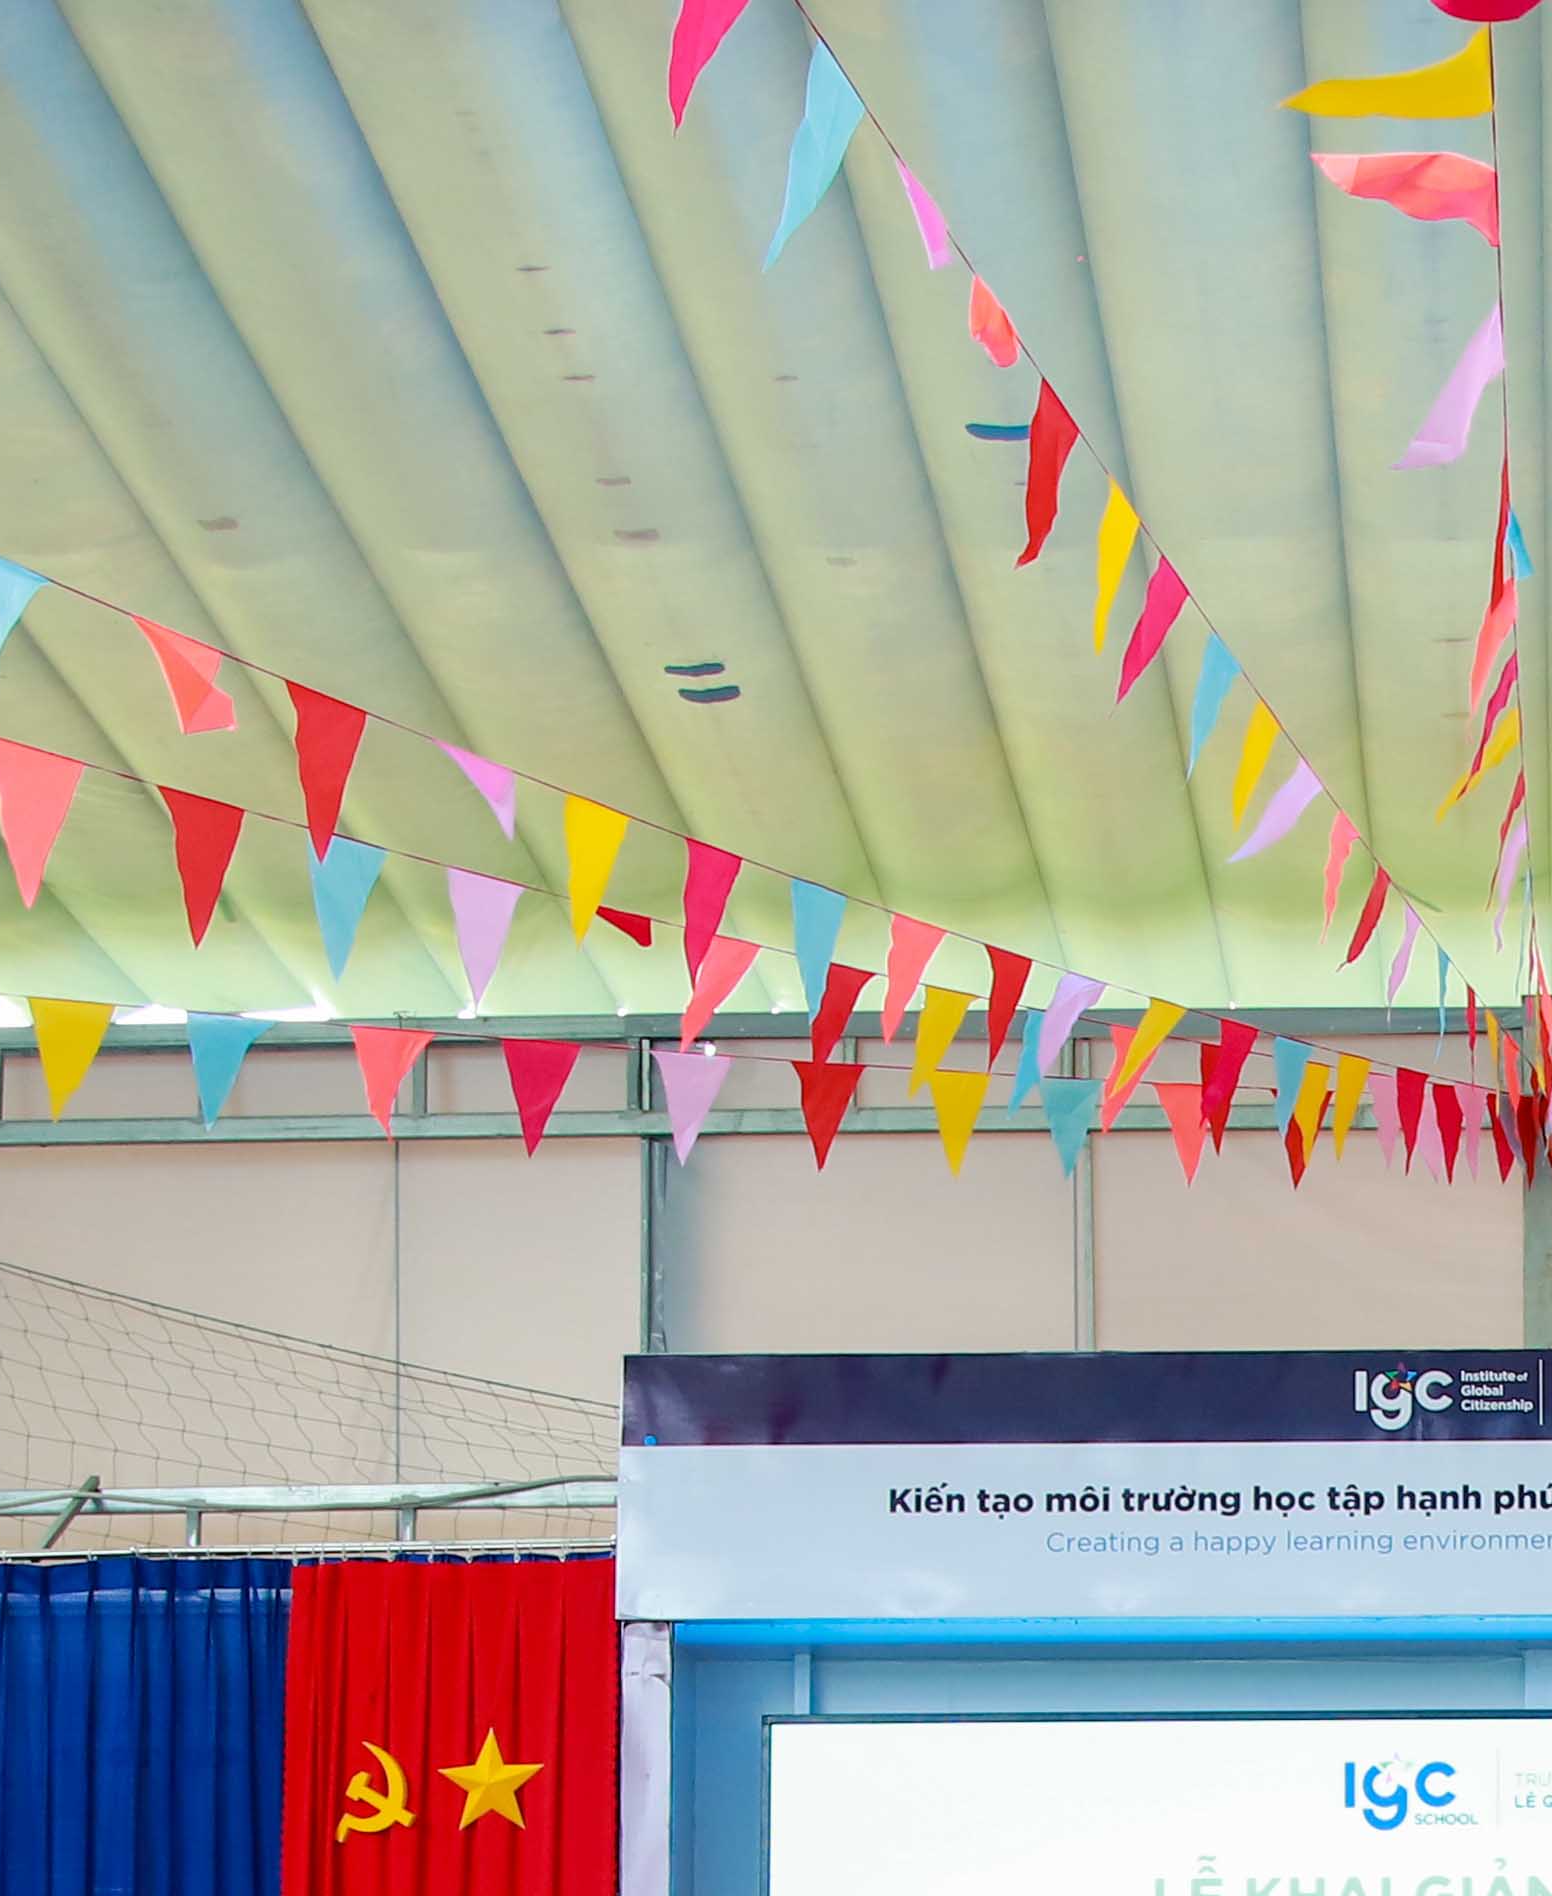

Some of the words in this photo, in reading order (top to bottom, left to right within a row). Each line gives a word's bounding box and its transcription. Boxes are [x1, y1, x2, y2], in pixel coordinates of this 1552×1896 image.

[1461, 1370, 1515, 1382] Institute
[1517, 1372, 1528, 1382] of
[1460, 1384, 1504, 1397] Global
[1460, 1399, 1534, 1413] Citizenship
[889, 1482, 965, 1513] Kiến
[977, 1489, 1034, 1517] tạo
[1046, 1486, 1110, 1513] môi
[1122, 1487, 1241, 1516] trường
[1254, 1484, 1313, 1517] học
[1327, 1485, 1384, 1517] tập
[1397, 1485, 1482, 1515] hạnh
[1046, 1531, 1159, 1556] Creating
[1170, 1538, 1183, 1553] a
[1194, 1530, 1276, 1556] happy
[1287, 1530, 1393, 1555] learning
[1514, 1791, 1536, 1808] LÊ
[1414, 1813, 1479, 1825] SCHOOL
